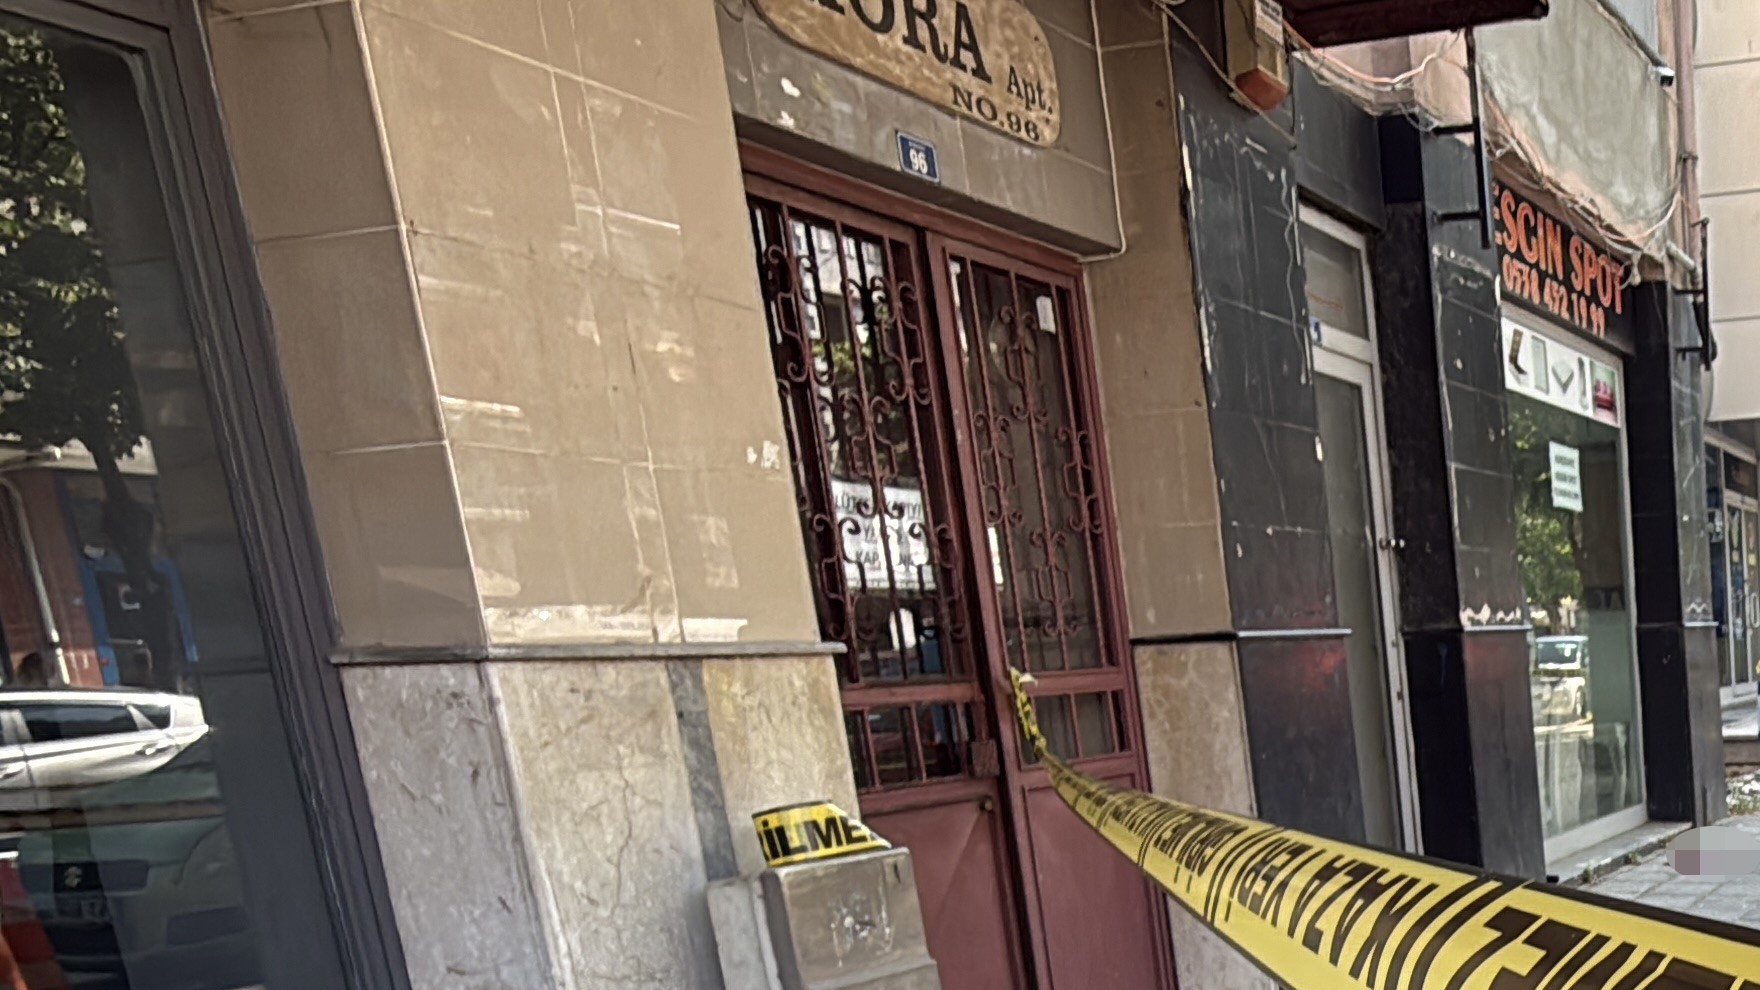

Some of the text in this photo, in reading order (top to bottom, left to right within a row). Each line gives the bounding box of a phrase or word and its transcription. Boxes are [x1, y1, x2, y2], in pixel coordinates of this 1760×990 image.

[812, 0, 993, 84] ORA
[1007, 65, 1053, 114] Apt.
[909, 148, 928, 174] 96
[1569, 235, 1622, 315] SPOT
[1286, 854, 1441, 990] KAZA
